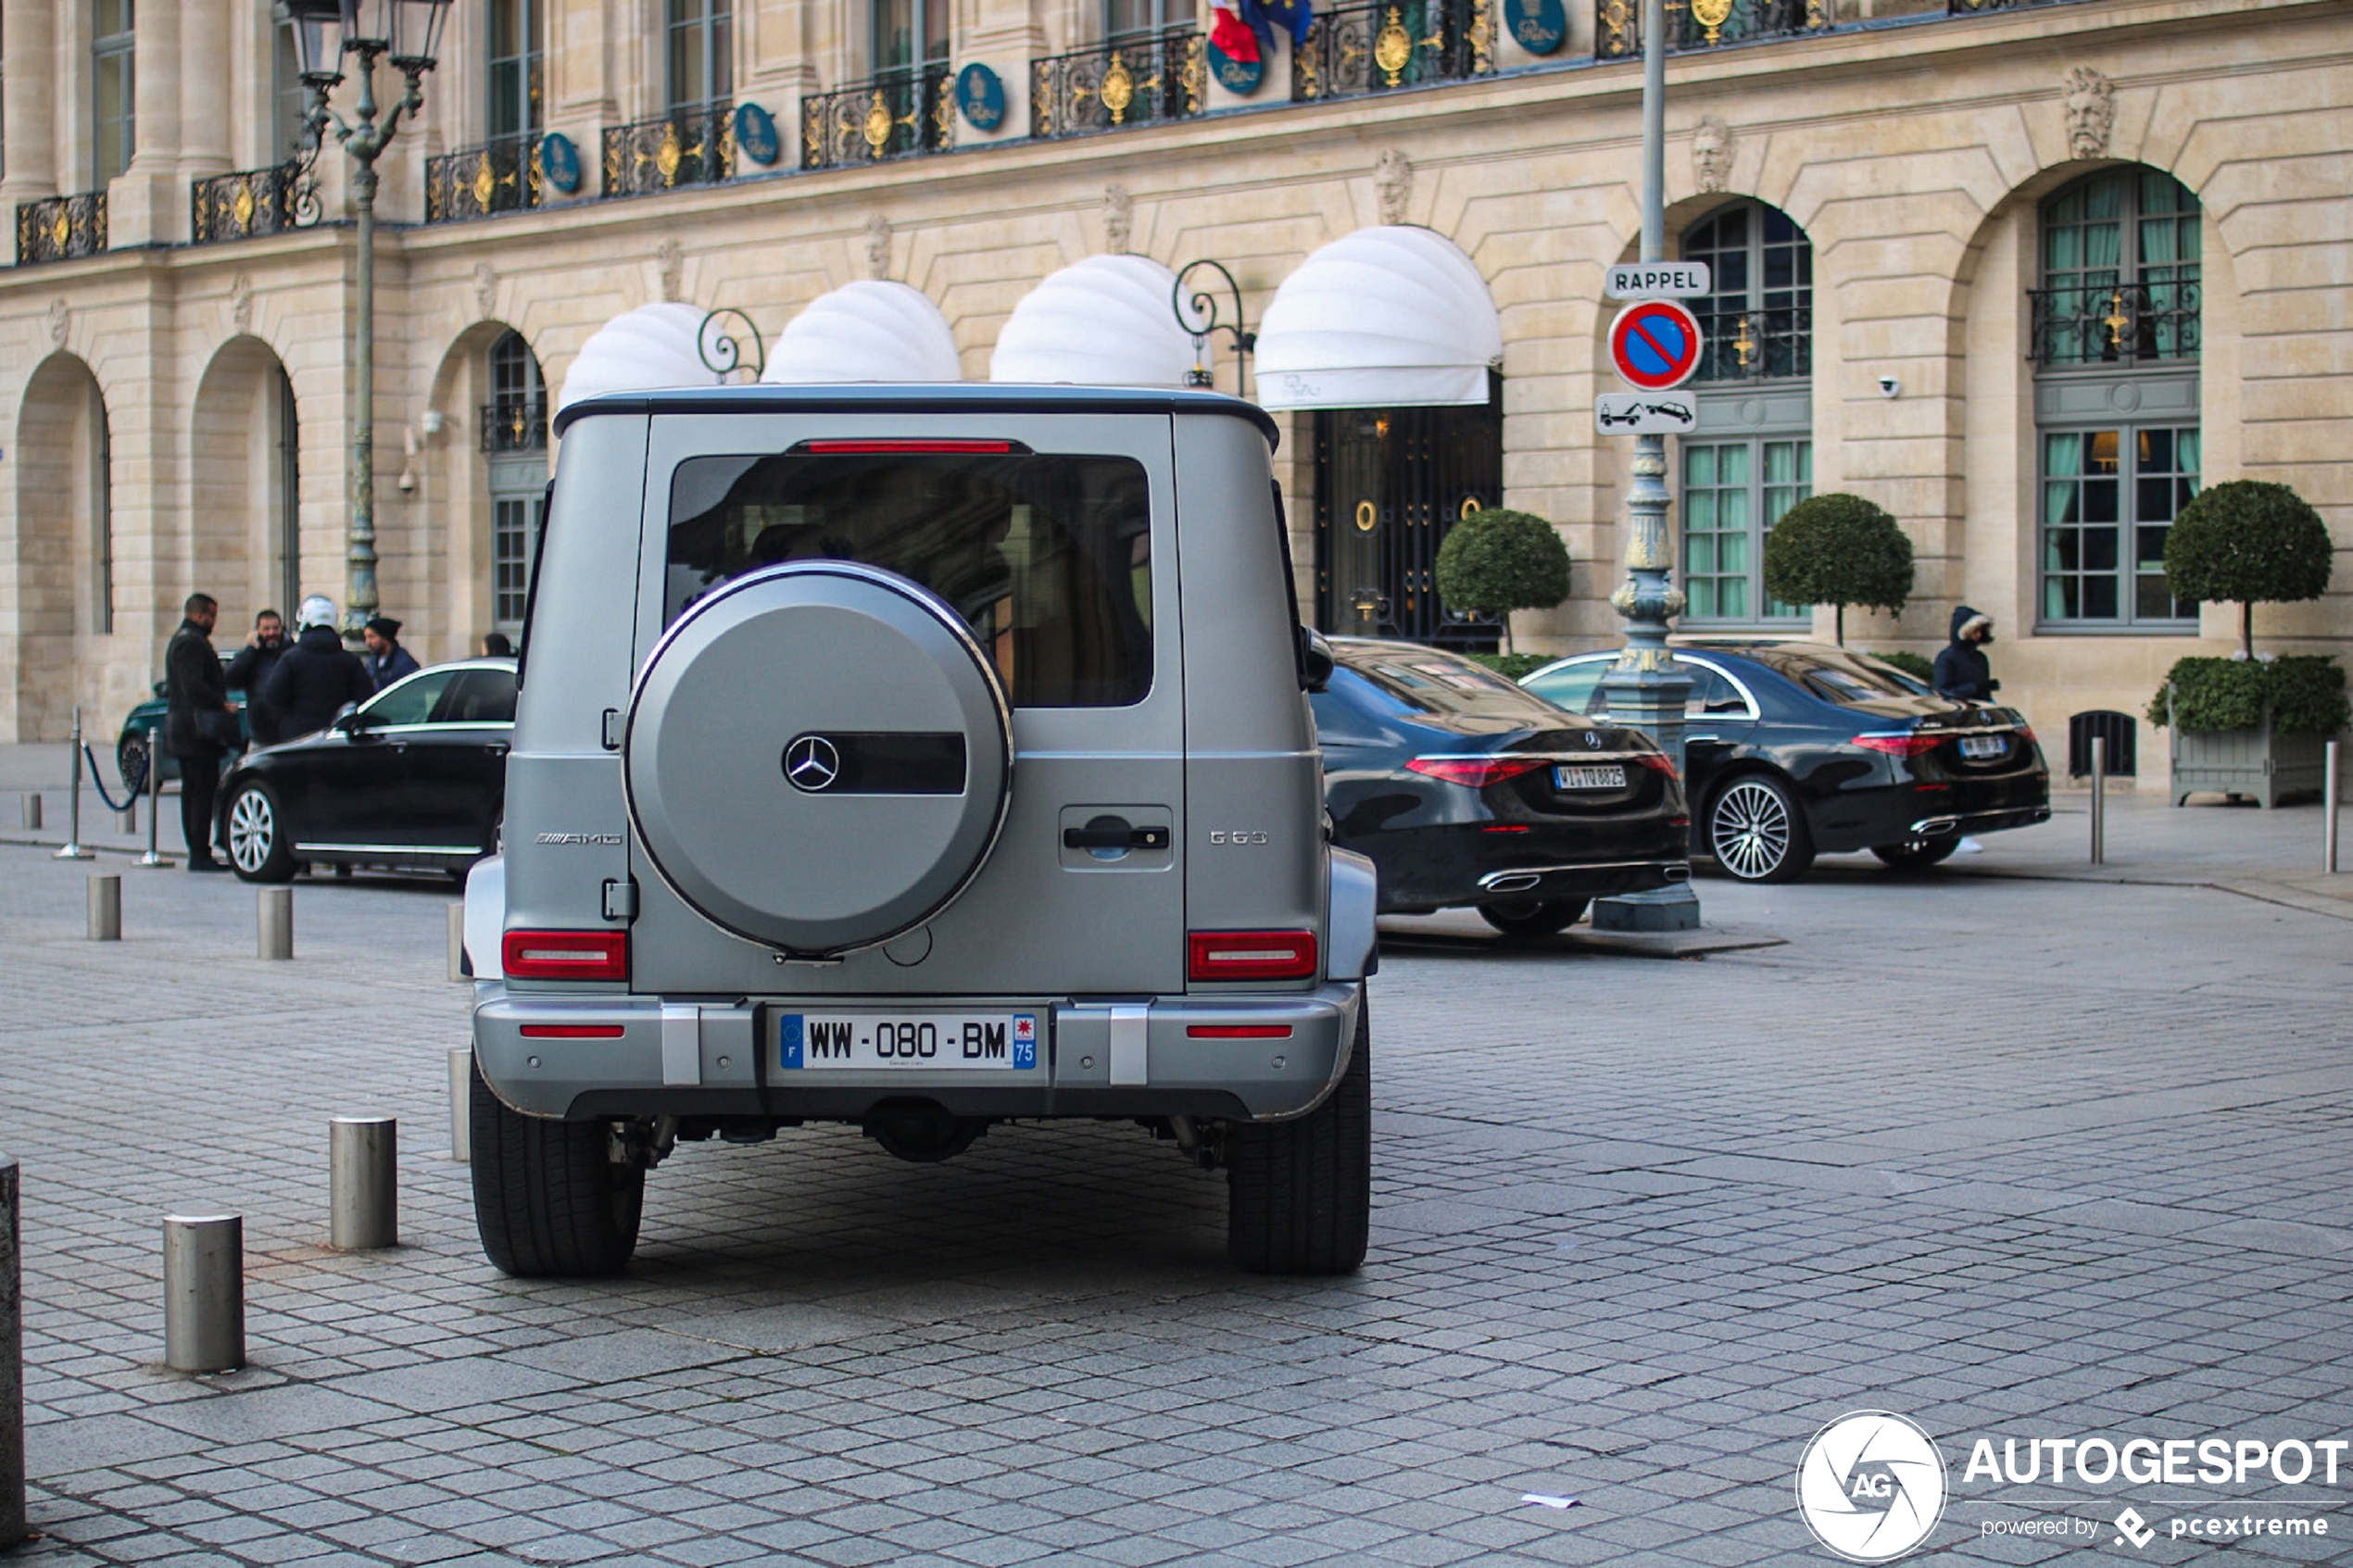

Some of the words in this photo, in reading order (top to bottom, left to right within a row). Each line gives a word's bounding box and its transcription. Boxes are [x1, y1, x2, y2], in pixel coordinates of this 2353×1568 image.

[1616, 271, 1699, 290] RAPPEL
[562, 834, 623, 845] AMG
[788, 1047, 796, 1058] F
[1016, 1045, 1033, 1061] 75
